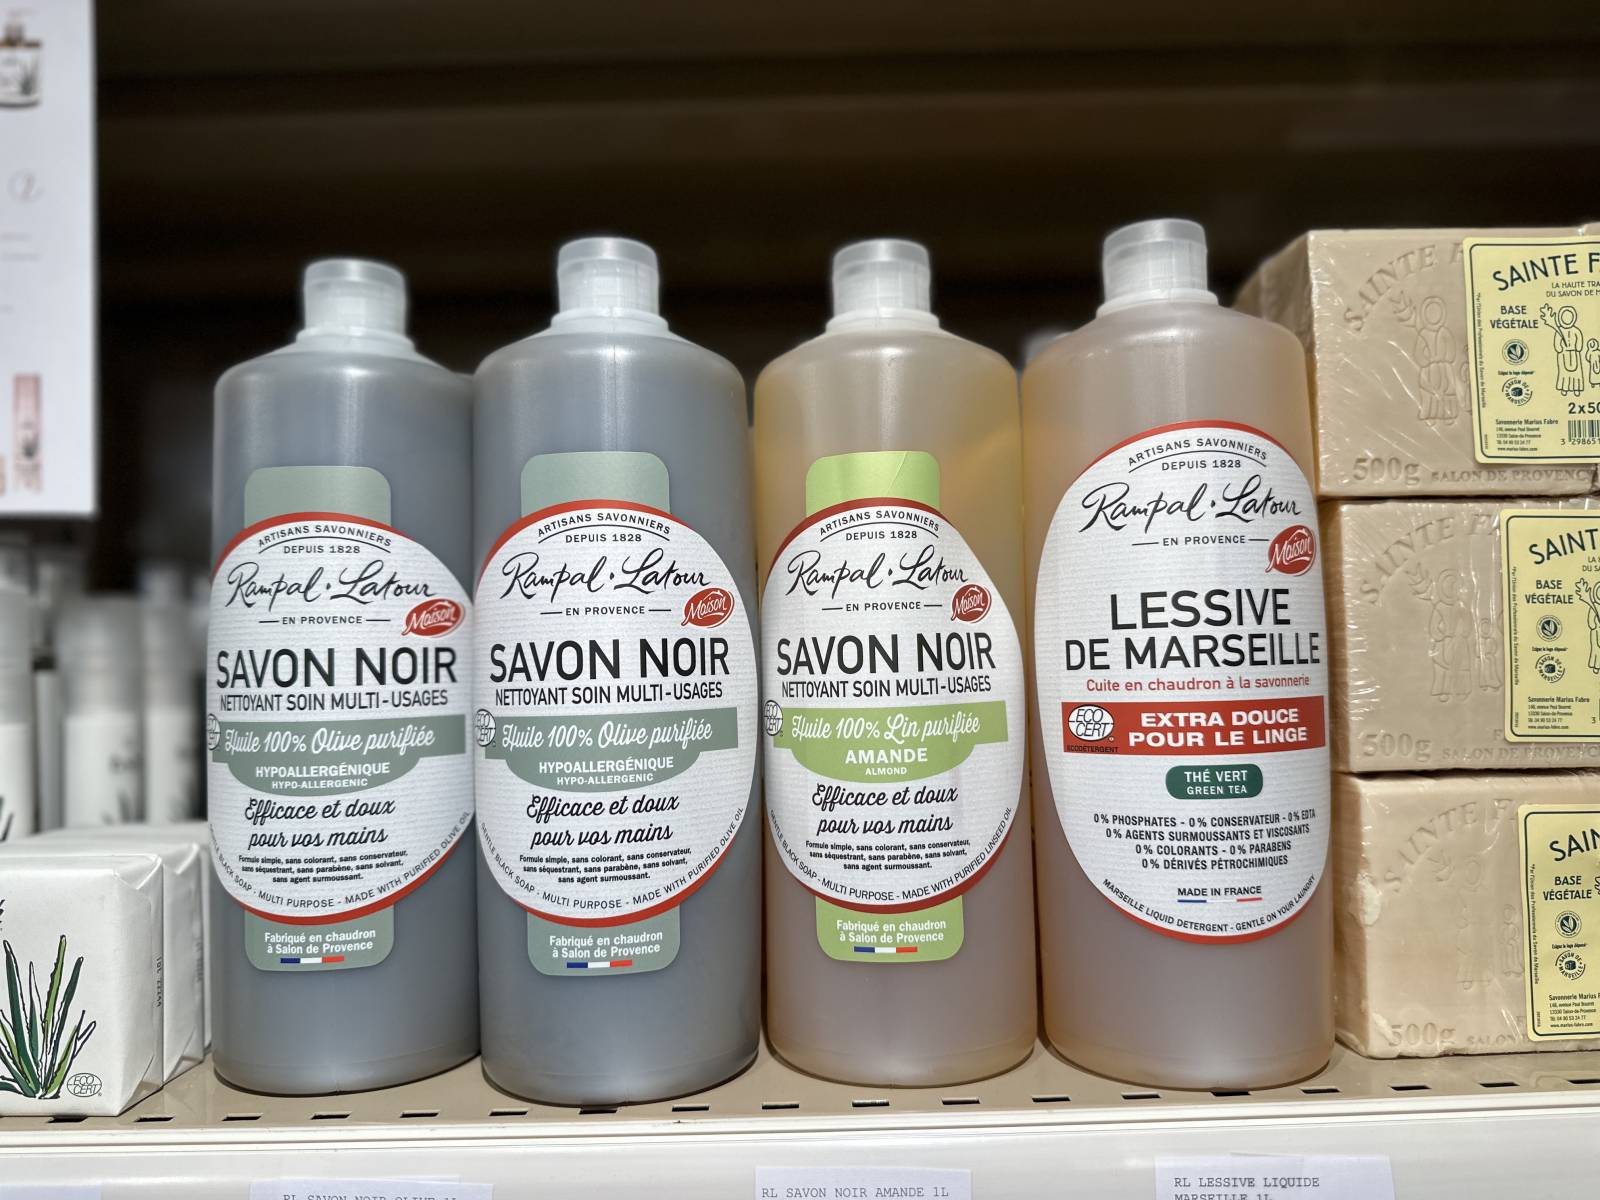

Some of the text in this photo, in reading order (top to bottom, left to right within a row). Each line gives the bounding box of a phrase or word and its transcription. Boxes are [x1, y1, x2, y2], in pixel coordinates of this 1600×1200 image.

[1493, 253, 1578, 291] SAINTE
[1500, 305, 1527, 315] BASE
[1490, 318, 1539, 329] VÉGÉTALE
[1128, 438, 1267, 466] ARTISANS SAVONNIERS
[1161, 459, 1242, 471] DEPUIS 1828
[1352, 457, 1421, 486] 500g
[1079, 474, 1302, 534] Rampal Latour
[538, 512, 672, 537] ARTISANS SAVONNIERS
[820, 510, 940, 536] ARTISANS SAVONNIERS
[258, 524, 393, 549] ARTISANS SAVONNIERS
[565, 533, 642, 544] DEPUIS 1828
[846, 530, 918, 541] DEPUIS 1828
[1162, 535, 1246, 547] EN PROVENCE
[500, 548, 712, 603] Rampal Latour
[785, 544, 969, 599] Rampal Latour
[225, 559, 439, 612] Rampal Latour
[1536, 580, 1563, 590] BASE
[846, 602, 921, 612] EN PROVENCE
[1525, 592, 1574, 604] VÉGÉTALE
[565, 606, 646, 616] EN PROVENCE
[1110, 588, 1291, 630] LESSIVE
[490, 637, 730, 682] SAVON NOIR
[776, 632, 996, 676] SAVON NOIR
[1065, 632, 1321, 671] DE MARSEILLE
[216, 646, 458, 688] SAVON NOIR
[782, 676, 992, 699] NETTOYANT SOIN MULTI-USAGES
[1086, 675, 1311, 692] Cuite en chaudron à la savonnerie
[220, 689, 449, 713] NETTOYANT SOIN MULTI-USAGES
[495, 682, 722, 706] NETTOYANT SOIN MULTI-USAGES
[1076, 708, 1104, 722] ECO
[1141, 708, 1299, 728] EXTRA DOUCE
[502, 718, 713, 752] Huile 100% Olive purifiée
[792, 711, 980, 745] Huile 100% Lin purifiée
[1075, 722, 1108, 738] CERT
[1128, 726, 1308, 748] POUR LE LINGE
[224, 724, 436, 756] Huile 100% Olive purifiée
[538, 756, 674, 774] HYPOALLERGÉNIQUE
[845, 748, 928, 765] AMANDE
[556, 773, 654, 785] HYPO-ALLERGENIC
[864, 766, 908, 776] ALMOND
[1184, 768, 1248, 783] THÉ VERT
[812, 783, 959, 812] Efficace et doux
[1186, 784, 1248, 796] GREEN TEA
[526, 793, 680, 824] Efficace et doux
[816, 814, 954, 837] pour vos mains
[1112, 814, 1177, 828] PHOSPHATES
[1210, 814, 1280, 828] CONSERVATEUR
[530, 824, 674, 850] pour vos mains
[1125, 824, 1310, 842] AGENTS SURMOUSSANTS ET VISCOSANTS
[514, 874, 535, 894] SOAP
[542, 891, 570, 906] MULTI
[574, 899, 623, 909] PURPOSE
[632, 890, 662, 905] MADE
[663, 876, 686, 896] WITH
[688, 846, 720, 880] PURIFIED
[720, 823, 738, 847] OLIVE
[734, 806, 744, 822] OIL
[1156, 841, 1292, 856] COLORANTS PARABENS
[1163, 854, 1288, 870] DÉRIVÉS PÉTROCHIMIQUES
[1554, 876, 1582, 886] BASE
[1177, 886, 1262, 897] MADE IN FRANCE
[1543, 889, 1593, 900] VÉGÉTALE
[1102, 878, 1145, 913] MARSEILLE
[1145, 907, 1175, 926] LIQUID
[1176, 920, 1229, 933] DETERGENT
[1235, 916, 1266, 932] GENTLE
[1266, 910, 1278, 922] ON
[1276, 900, 1295, 918] YOUR
[549, 932, 663, 950] Fabriqué en chaudron
[552, 943, 660, 958] à Salon de Provence
[74, 1073, 95, 1084] ECO
[73, 1085, 98, 1096] CERT
[1174, 1178, 1320, 1188] RL LESSIVE LIQUIDE
[762, 1188, 777, 1198] RL
[786, 1188, 826, 1198] SAVON
[835, 1188, 868, 1198] NOIR
[875, 1188, 924, 1198] AMANDE
